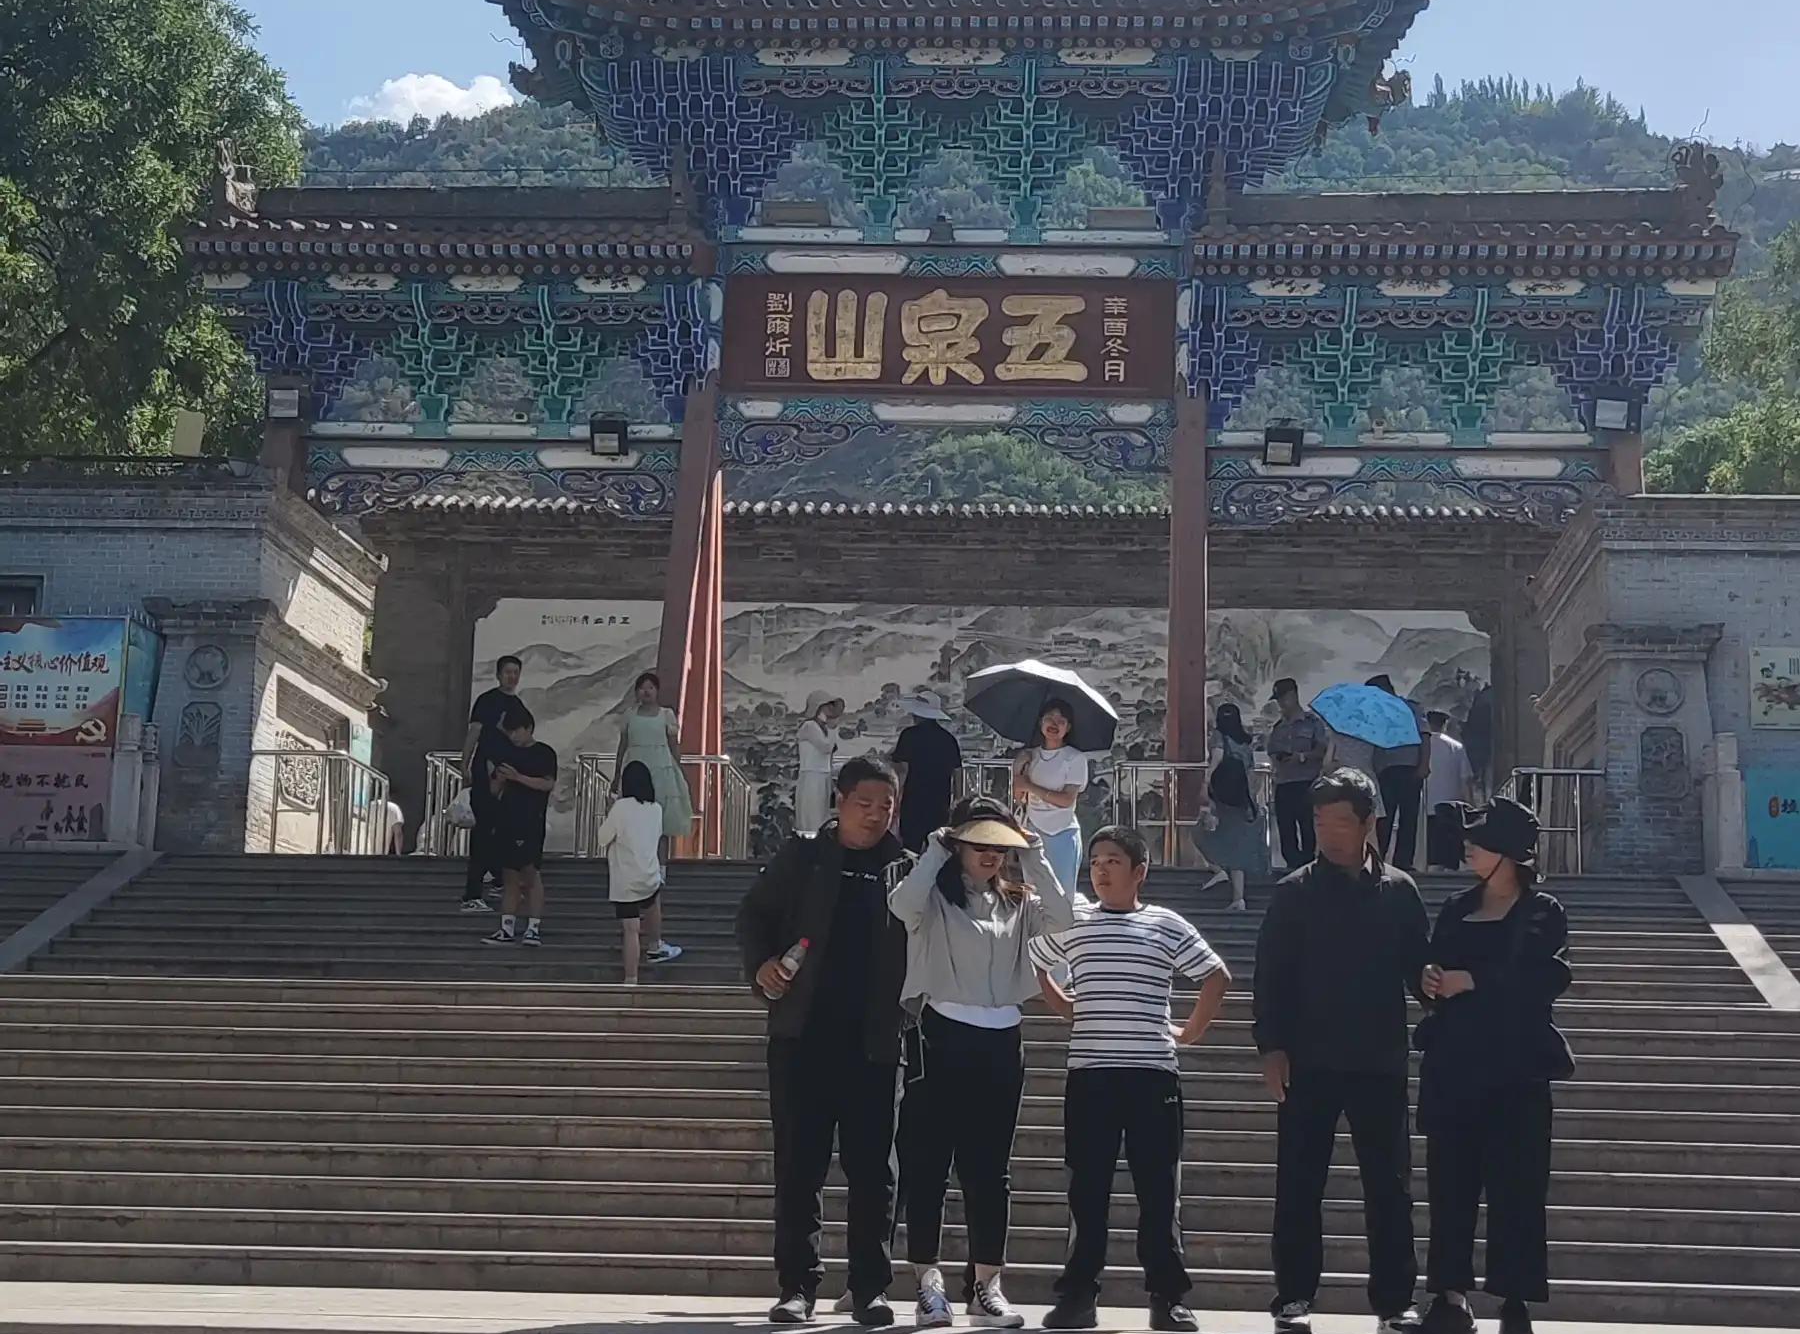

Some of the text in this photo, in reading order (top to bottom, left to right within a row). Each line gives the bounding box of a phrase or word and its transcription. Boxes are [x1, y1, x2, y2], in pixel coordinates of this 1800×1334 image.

[0, 650, 110, 676] 主义核心价值观
